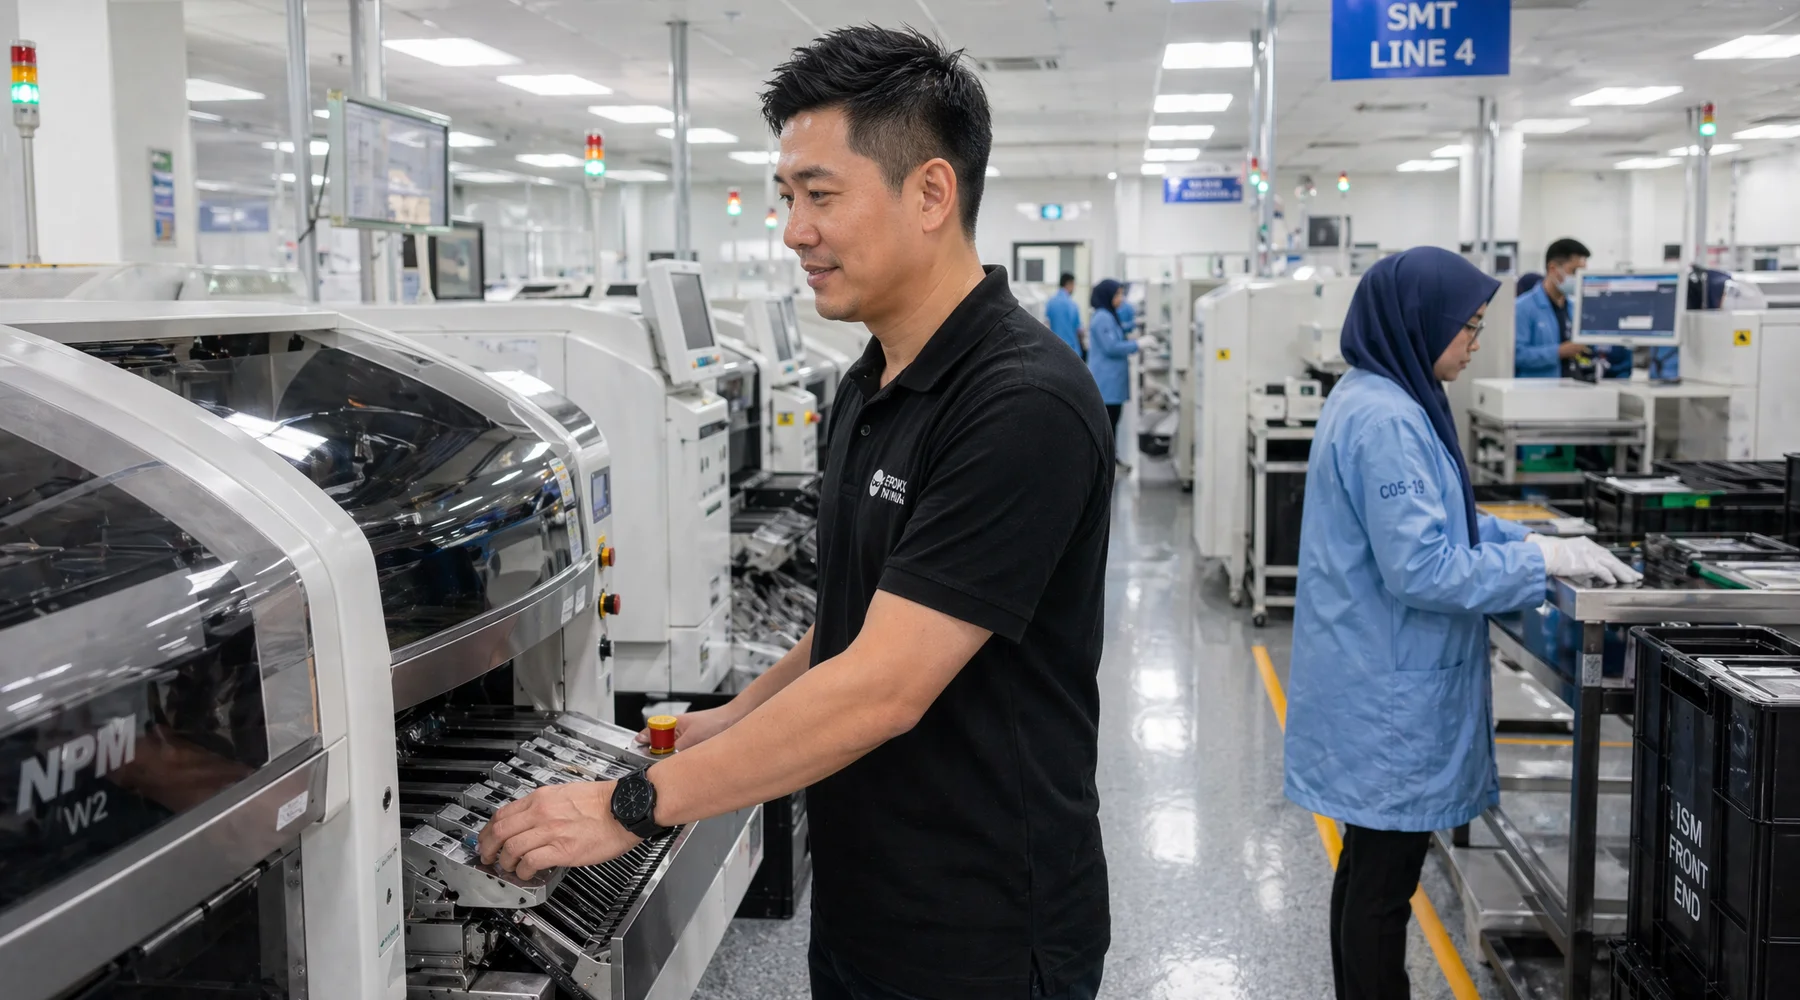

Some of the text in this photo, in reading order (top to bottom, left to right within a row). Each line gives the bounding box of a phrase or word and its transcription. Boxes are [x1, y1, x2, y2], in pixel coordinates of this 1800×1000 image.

[1387, 1, 1458, 31] SMT
[1370, 37, 1476, 69] LINE 4
[16, 712, 136, 815] NPM
[64, 790, 108, 835] W2
[1669, 833, 1709, 889] FRONT
[1674, 874, 1701, 921] END
